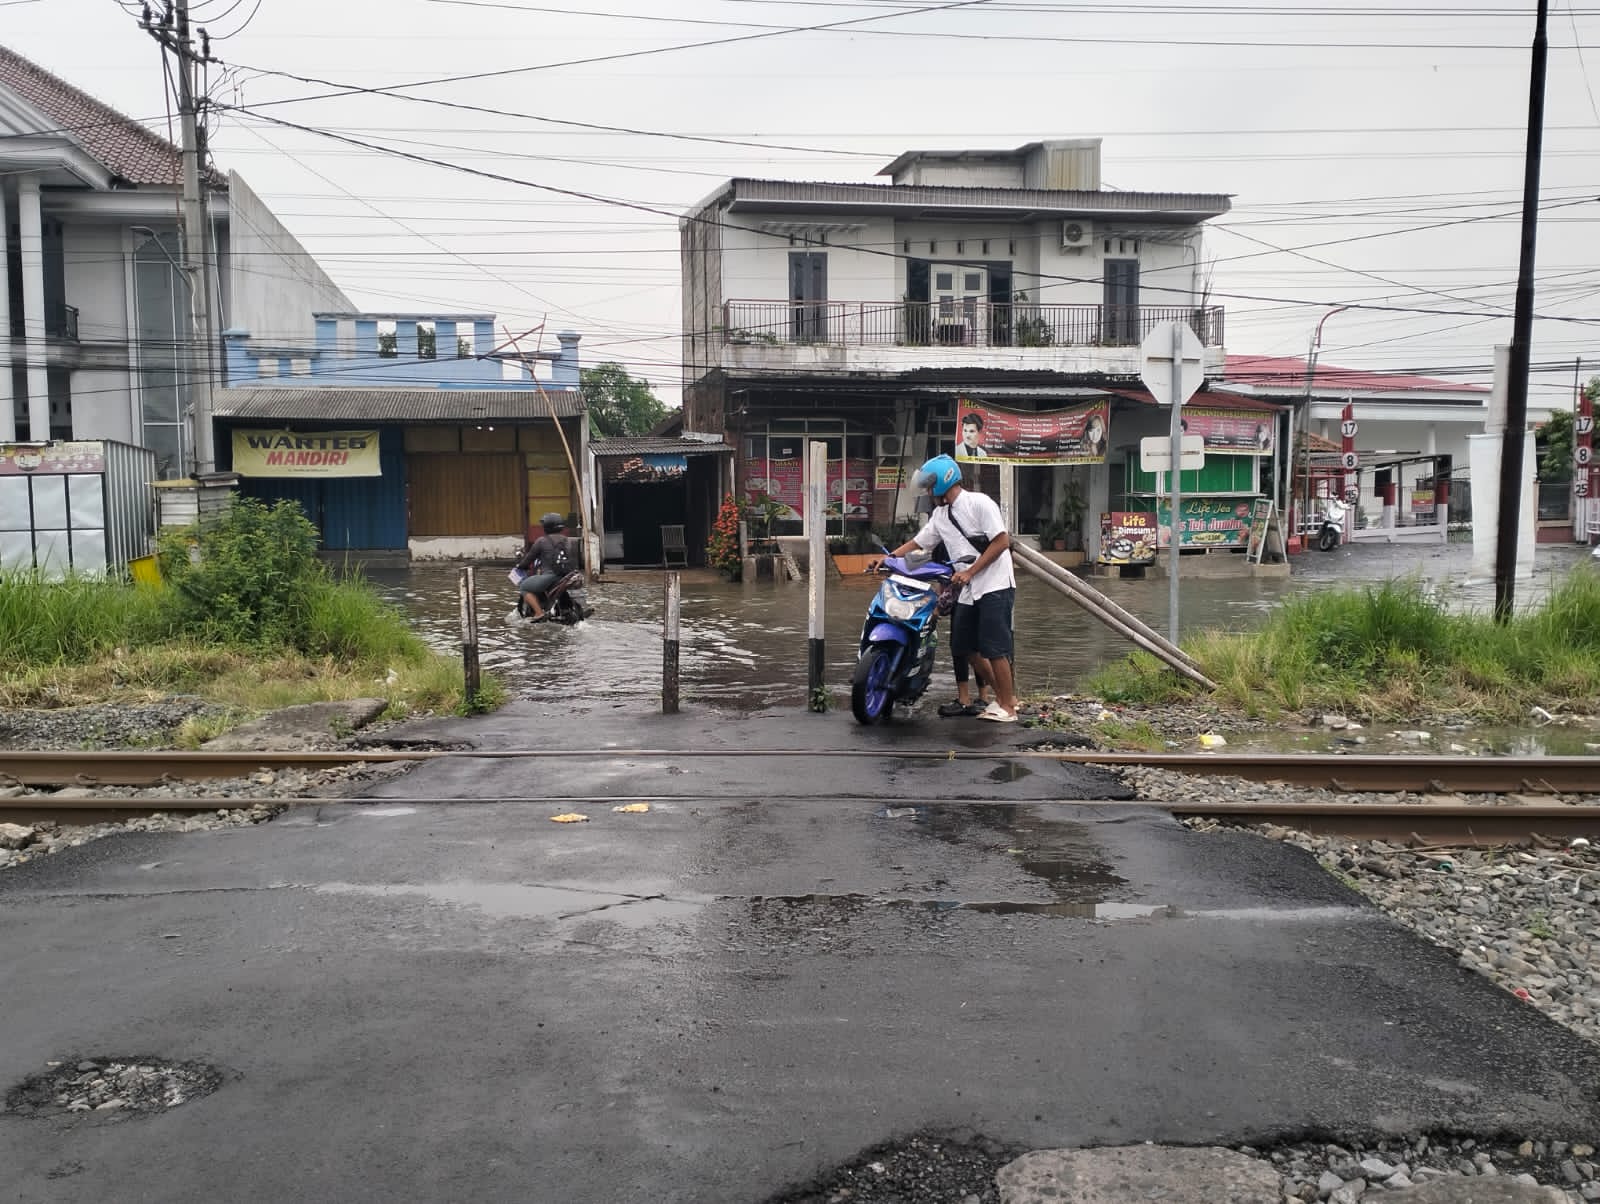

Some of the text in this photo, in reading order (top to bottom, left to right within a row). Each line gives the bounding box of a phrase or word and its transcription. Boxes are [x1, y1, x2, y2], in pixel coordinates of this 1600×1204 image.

[1343, 422, 1356, 435] 17
[1576, 418, 1591, 431] 17
[247, 436, 367, 449] WARTEG
[266, 451, 349, 466] MANDIRI
[1346, 454, 1354, 467] 8
[1579, 448, 1587, 461] 8
[1185, 501, 1210, 517] Life
[1123, 514, 1146, 526] Life
[1118, 526, 1151, 535] Dimsum
